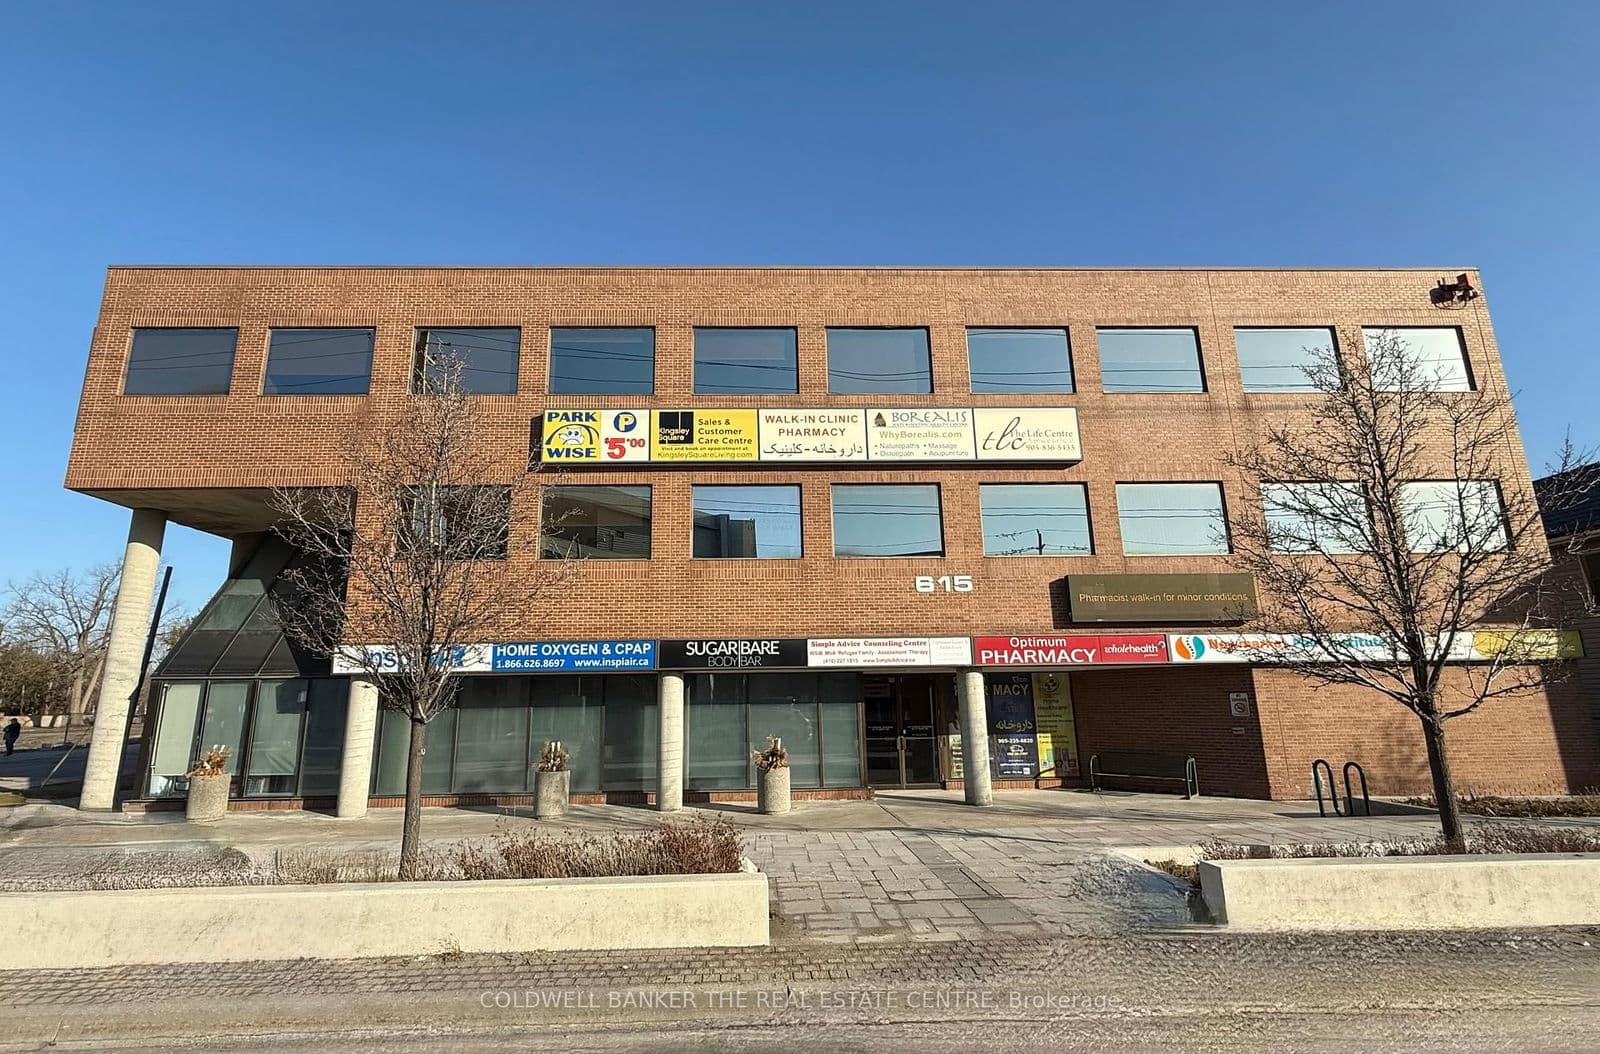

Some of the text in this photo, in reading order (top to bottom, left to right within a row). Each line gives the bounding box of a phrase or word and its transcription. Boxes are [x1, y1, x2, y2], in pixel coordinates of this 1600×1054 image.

[547, 411, 597, 422] PARK
[698, 418, 722, 426] Sales
[765, 415, 859, 424] WALK-IN CLINIC
[892, 411, 967, 422] BOREALIS
[659, 427, 690, 436] Kingsley
[778, 428, 846, 437] PHARMACY
[880, 431, 962, 440] WhyBorealis.com
[1027, 429, 1042, 437] Life
[1044, 429, 1073, 437] Centre
[659, 434, 685, 445] Square
[547, 447, 597, 458] WISE
[915, 575, 973, 592] 615
[1079, 592, 1248, 602] Pharmacist walk-in for minor conditions
[1009, 637, 1067, 649] Optimum
[1104, 643, 1158, 653] wholehealth
[497, 643, 652, 657] HOME OXYGEN & CPAP
[981, 648, 1097, 664] PHARMACY
[496, 657, 649, 669] 1.866.626.8697 www.inspiair.ca
